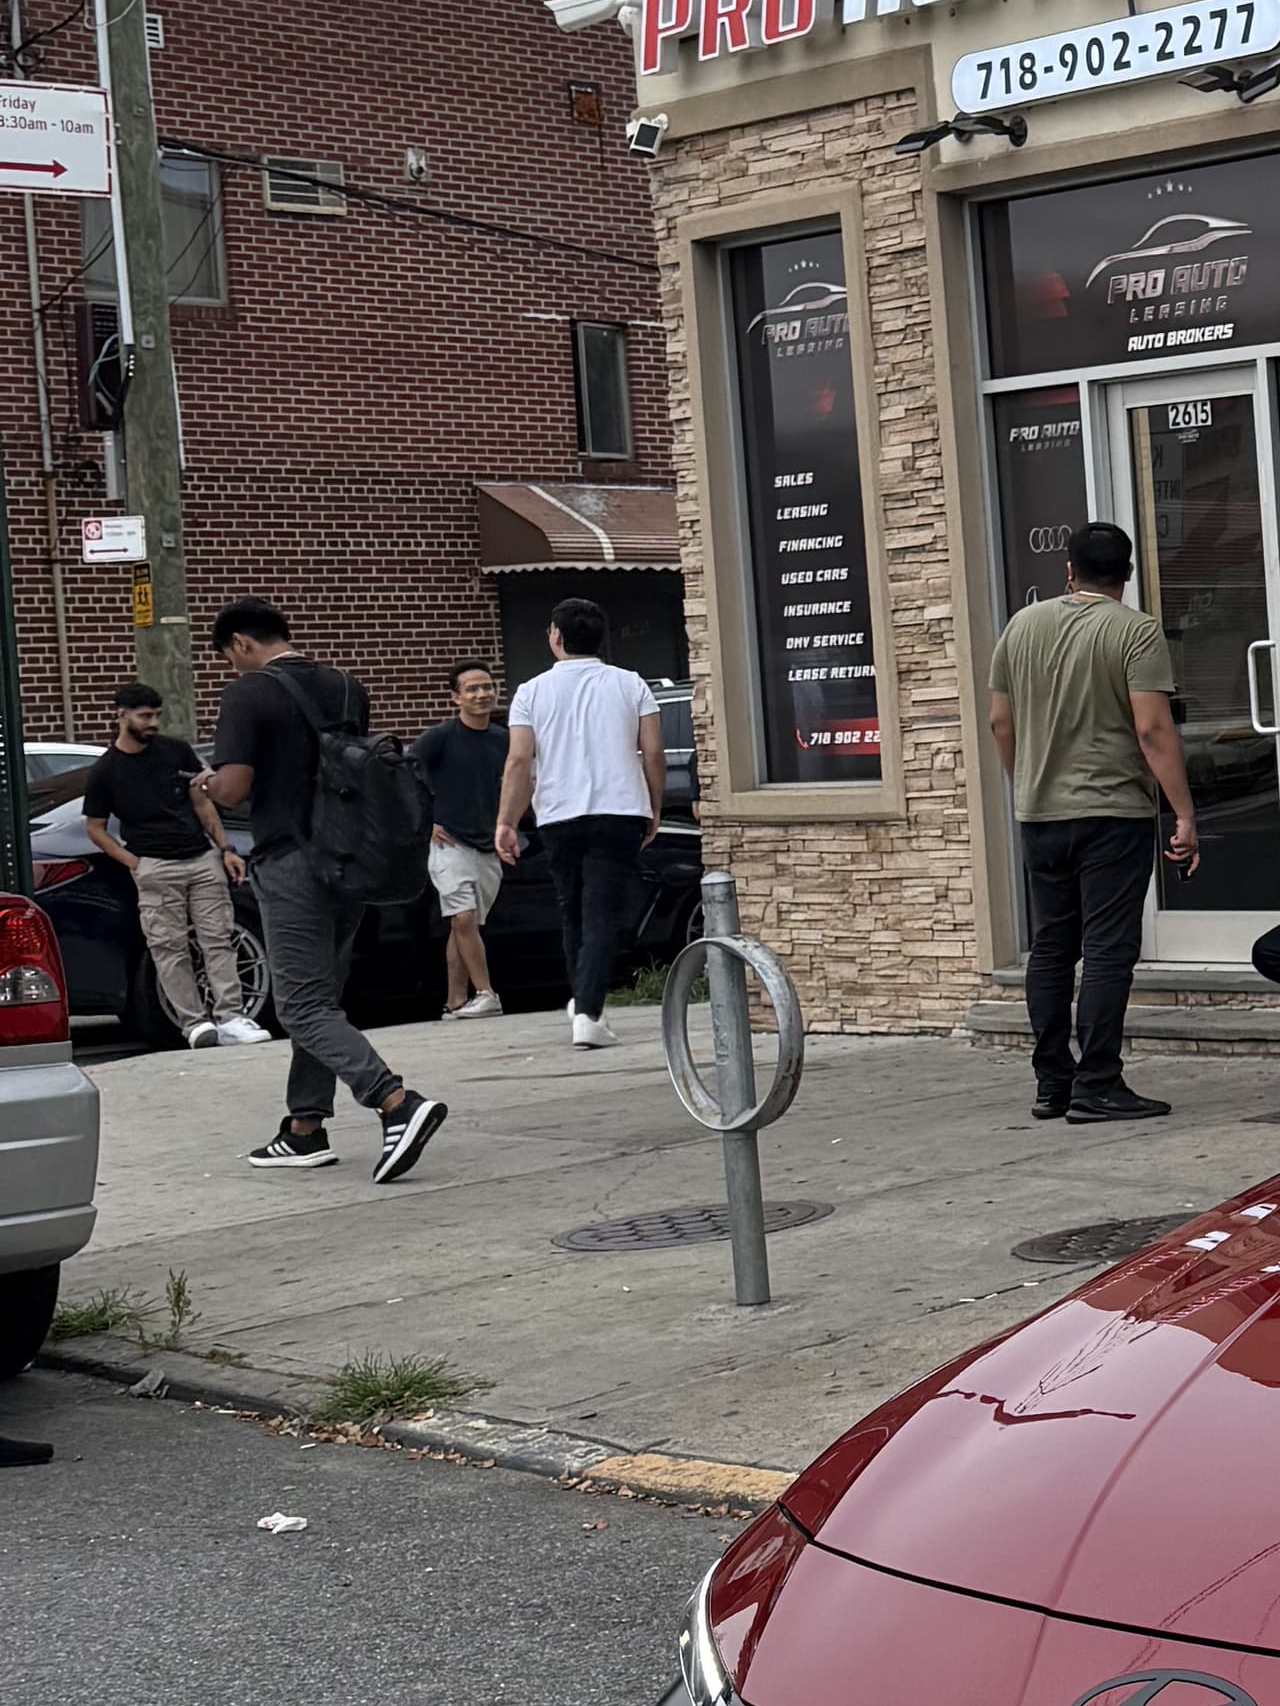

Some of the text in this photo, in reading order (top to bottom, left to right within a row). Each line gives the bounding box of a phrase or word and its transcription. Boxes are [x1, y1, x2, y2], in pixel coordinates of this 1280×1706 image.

[975, 2, 1257, 101] 718-902-2277
[60, 119, 94, 134] 10am
[1107, 256, 1249, 304] PRO AUTO
[1129, 295, 1228, 323] LEASING
[762, 320, 801, 345] PRO
[1128, 323, 1234, 352] AUTO BROKERS
[1170, 402, 1209, 427] 2615
[1009, 420, 1080, 442] PRO AUTO
[774, 472, 814, 488] SALES
[776, 504, 829, 520] LEASING
[779, 535, 844, 553] FINANCING
[781, 568, 849, 585] USED CARS
[784, 601, 852, 617] INSURANCE
[786, 633, 865, 649] DMV SERVICE
[788, 667, 828, 682] LEASE
[810, 732, 831, 745] 718
[834, 731, 860, 744] 902
